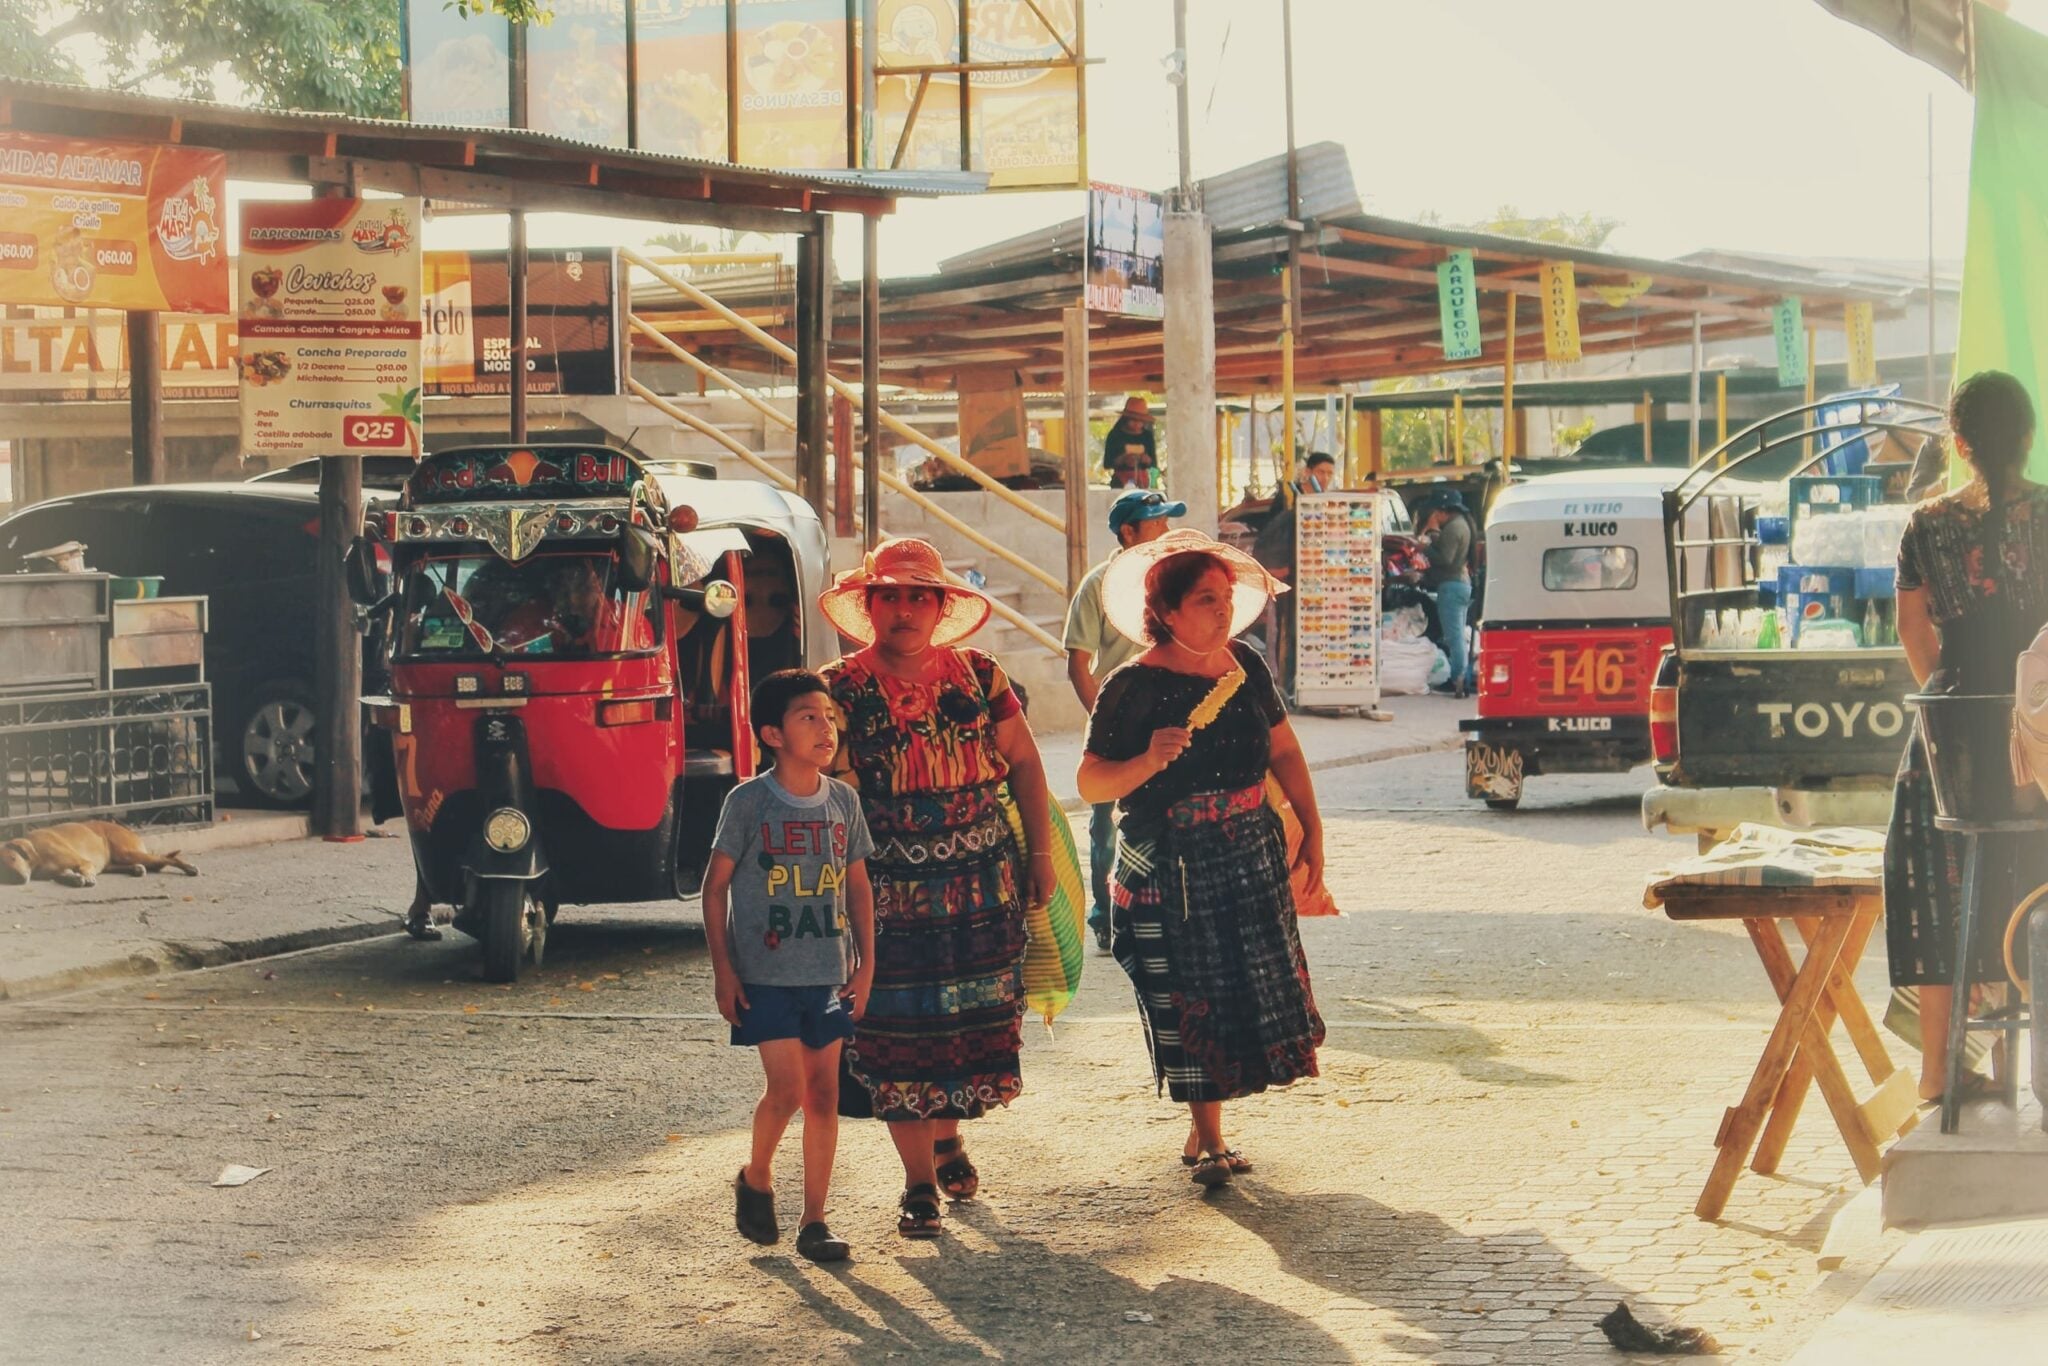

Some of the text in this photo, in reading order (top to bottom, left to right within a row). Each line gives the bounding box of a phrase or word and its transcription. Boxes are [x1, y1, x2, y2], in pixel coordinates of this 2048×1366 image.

[60, 154, 142, 186] ALTAMAR
[53, 196, 120, 215] Caldo de gallina
[163, 198, 188, 221] ALTA
[161, 219, 185, 237] MAR
[251, 227, 342, 241] RAPICOMIDAS
[352, 229, 378, 242] MAR
[0, 244, 34, 259] 60.00
[97, 250, 133, 265] Q60.00
[286, 264, 376, 294] Ceviches
[1449, 253, 1467, 330] PARQUEO
[344, 298, 375, 306] Q25.00
[1550, 265, 1568, 338] PARQUEO
[344, 308, 376, 316] Q50.00
[1454, 330, 1469, 340] 10
[483, 337, 542, 349] ESPEAL
[297, 348, 407, 359] Concha Preparada
[311, 363, 345, 371] Docena
[376, 364, 407, 372] Q50.00
[484, 361, 536, 372] MODO
[297, 375, 343, 383] Michelada
[464, 381, 496, 394] DAÑOS
[498, 383, 505, 393] A
[289, 399, 372, 410] Churrasquitos
[292, 430, 332, 438] adobada
[352, 420, 395, 442] Q25
[420, 453, 628, 489] Red Bull
[1563, 502, 1622, 514] EL VIEJO
[1564, 521, 1617, 537] K-LUCO
[1550, 649, 1624, 695] 146
[1548, 717, 1611, 731] K-LUCO
[761, 820, 848, 858] LET'S
[767, 863, 847, 897] PLAY
